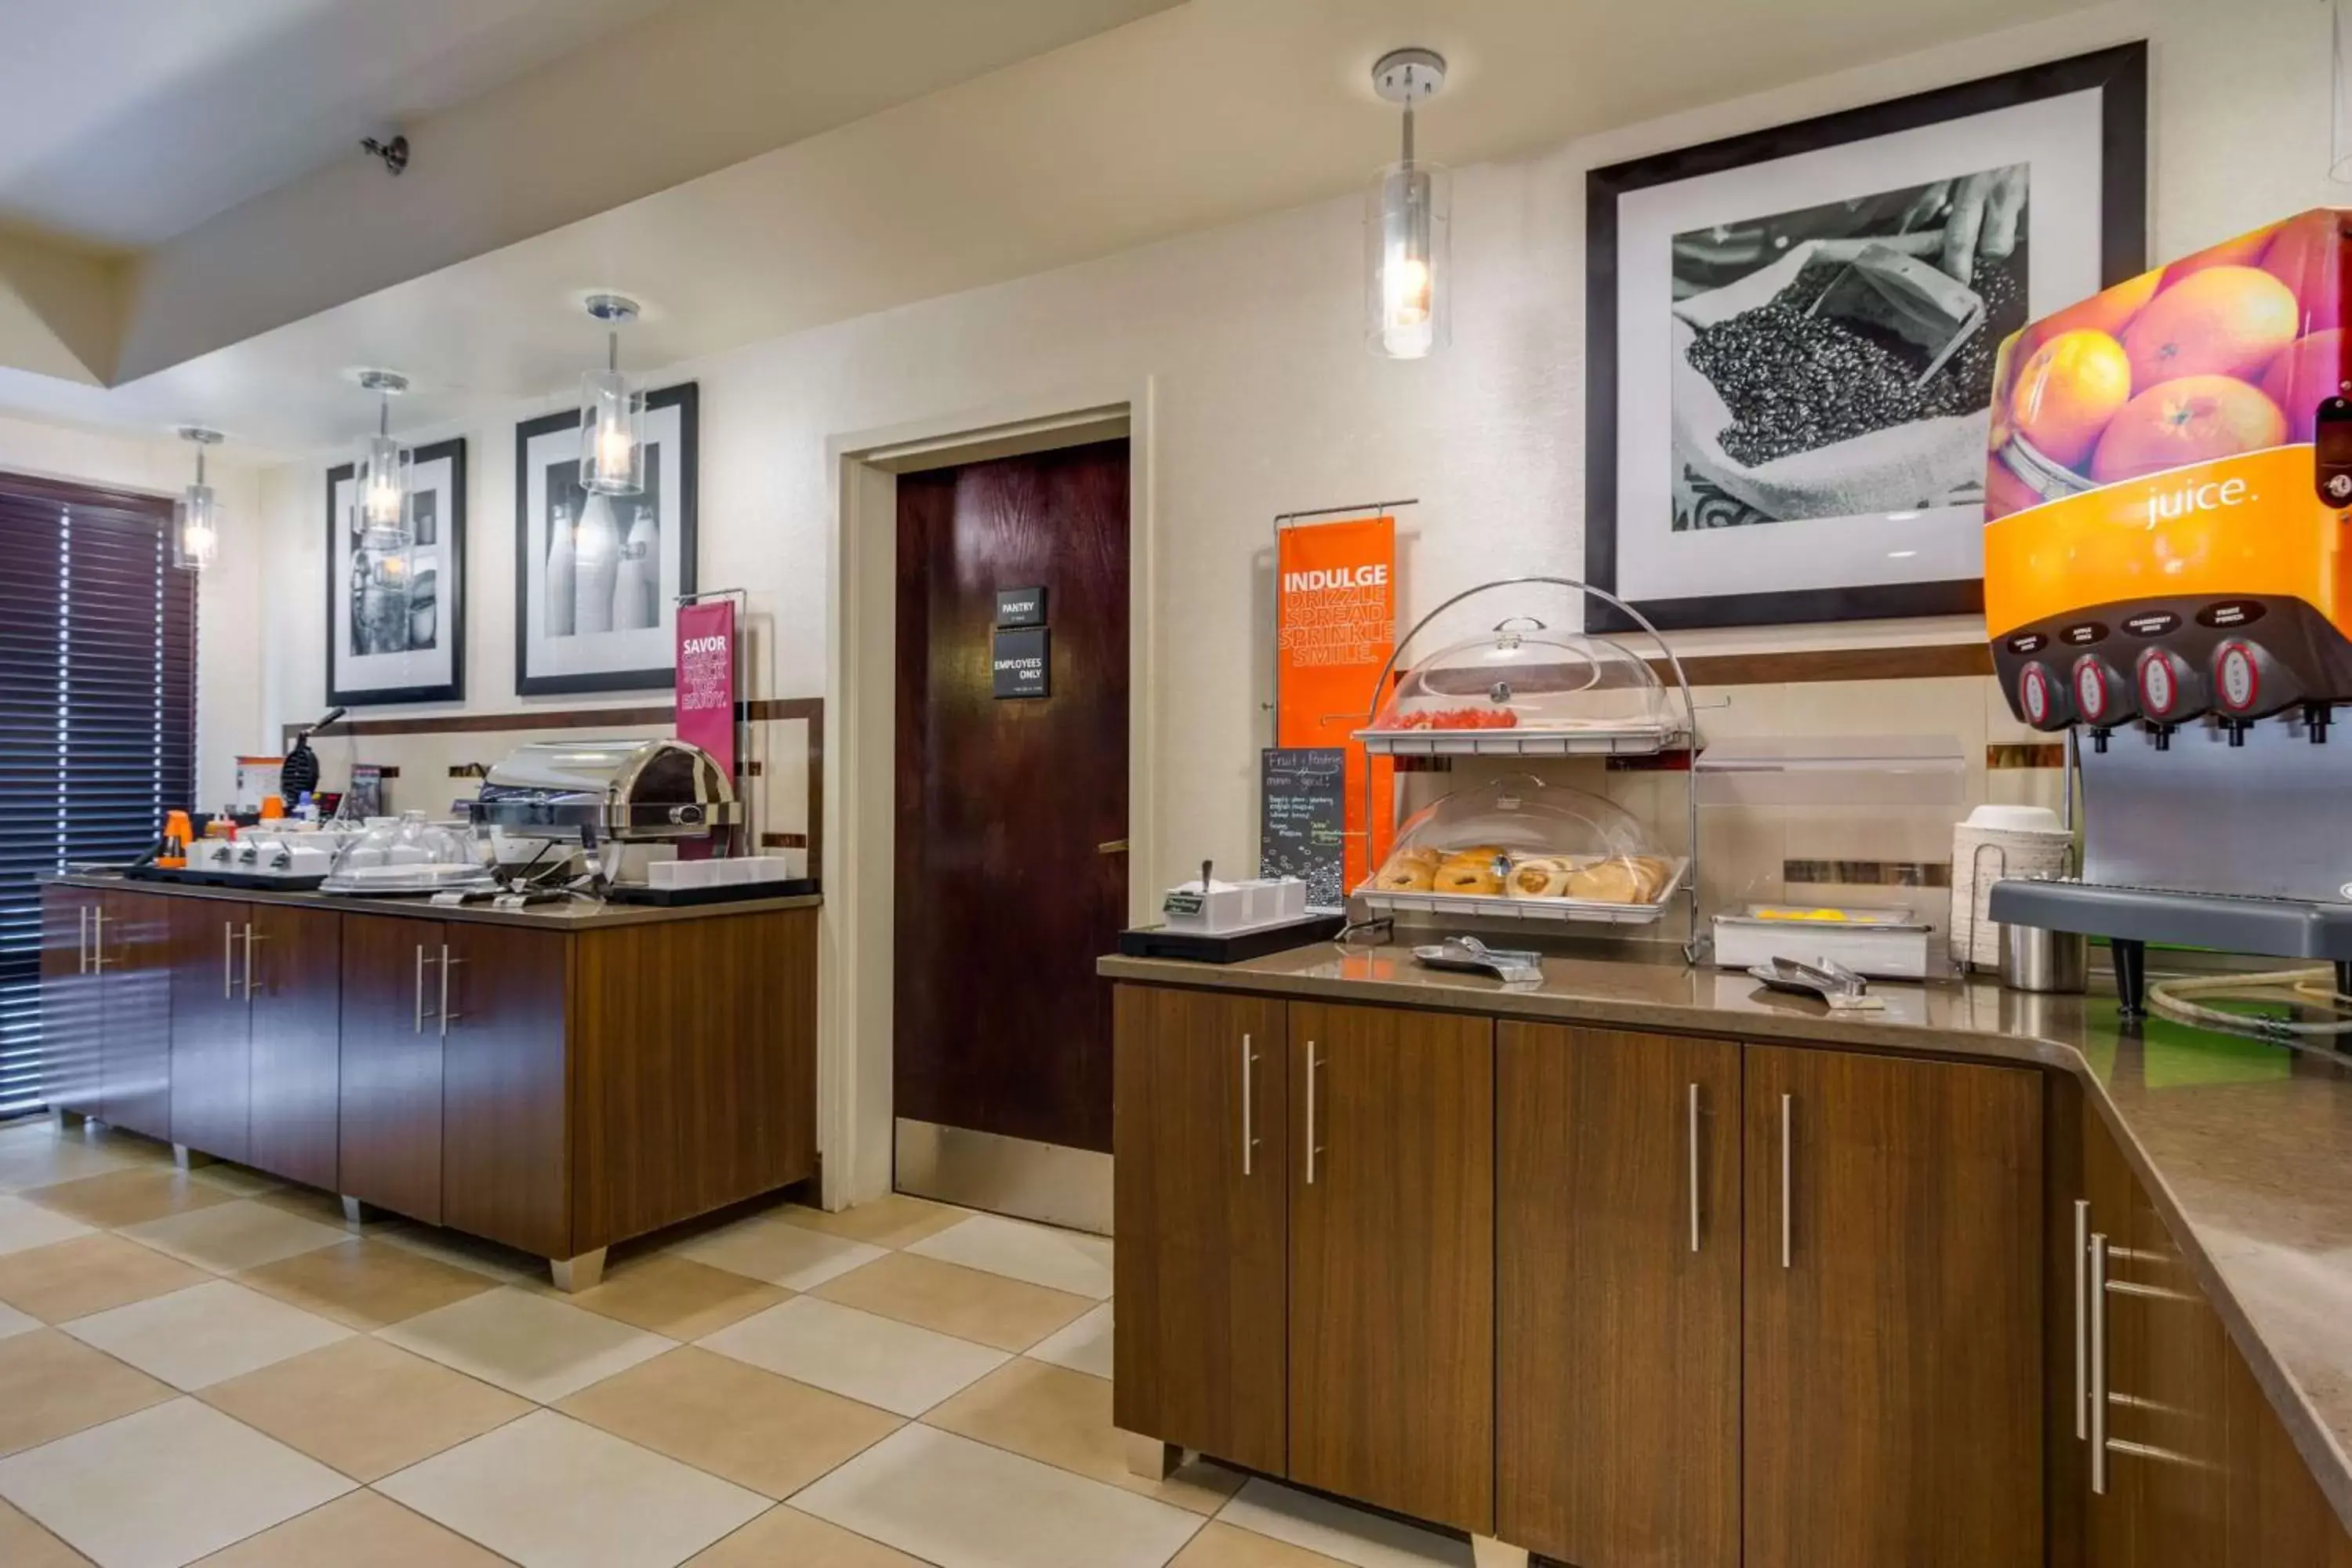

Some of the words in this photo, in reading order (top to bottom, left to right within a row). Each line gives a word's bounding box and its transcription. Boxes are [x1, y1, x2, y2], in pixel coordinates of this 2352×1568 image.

[2146, 477, 2259, 531] juice.
[1283, 564, 1388, 593] INDULGE
[1002, 601, 1034, 613] PANTRY
[1286, 586, 1386, 609] DRIZZLE
[1286, 602, 1385, 630] SPREAD
[683, 636, 726, 655] SAVOR
[1279, 620, 1394, 651] SPRINKLE
[994, 658, 1042, 670] EMPLOYEES
[1019, 669, 1042, 681] ONLY
